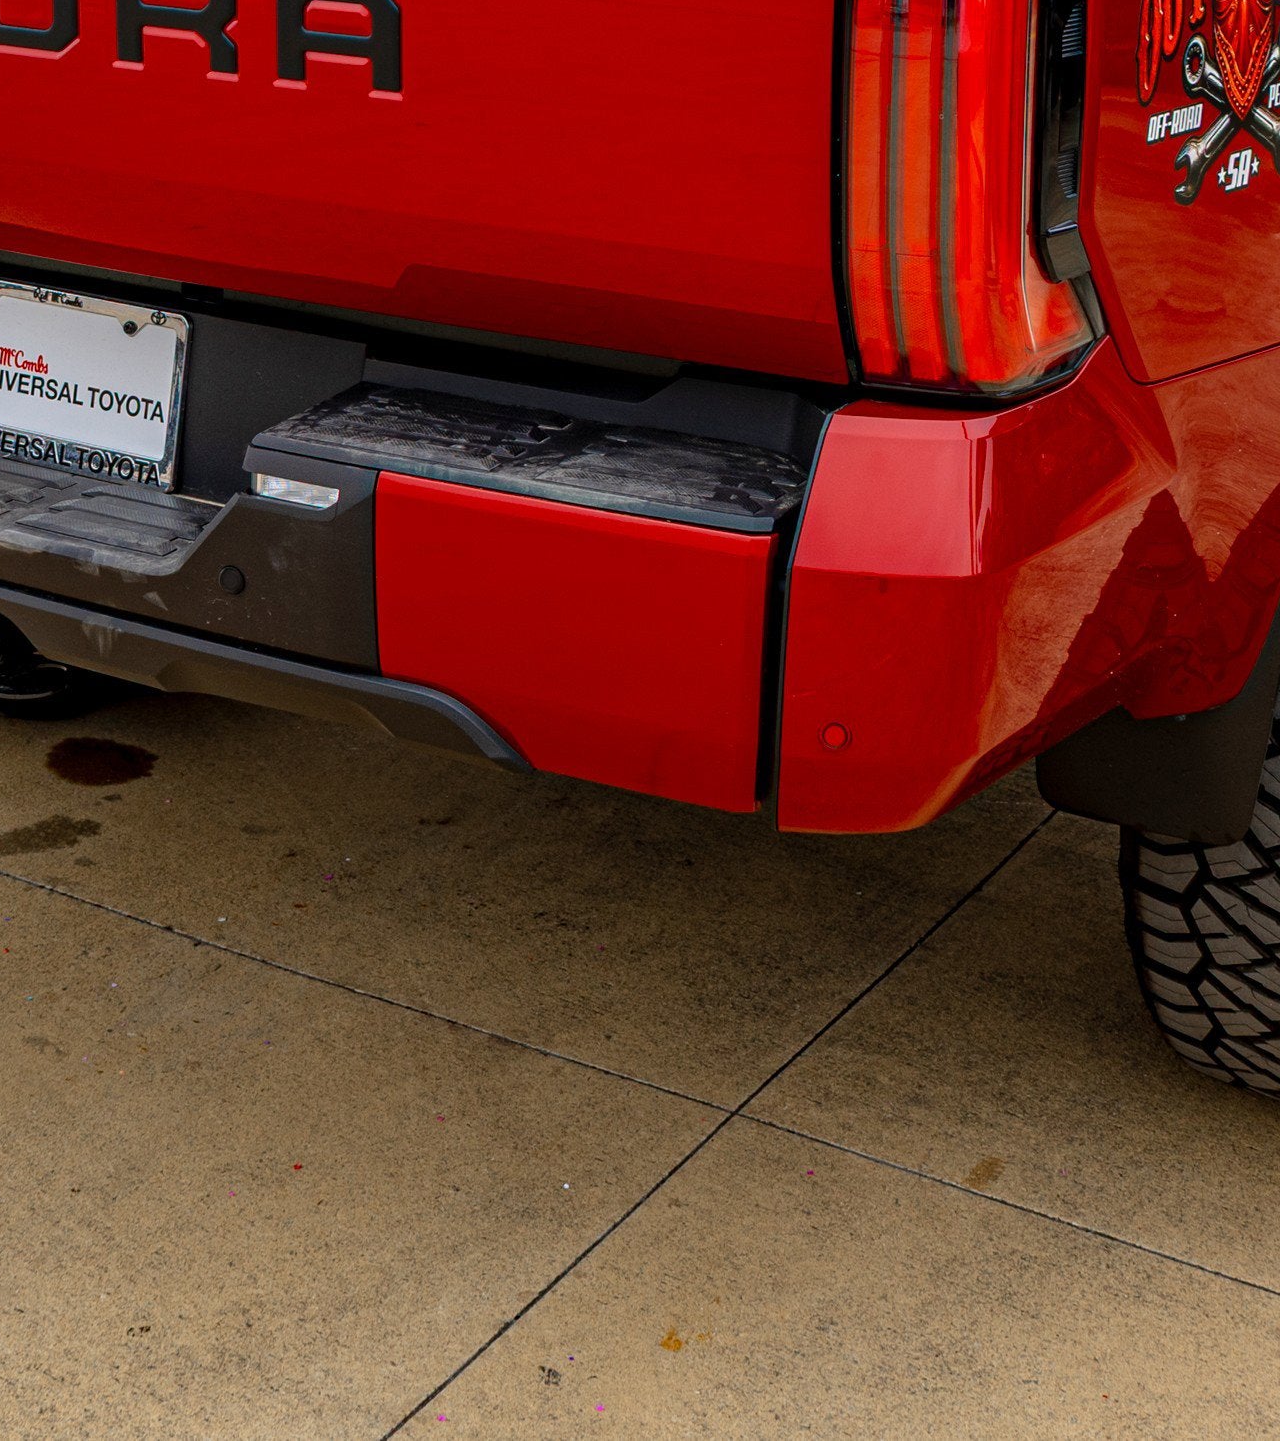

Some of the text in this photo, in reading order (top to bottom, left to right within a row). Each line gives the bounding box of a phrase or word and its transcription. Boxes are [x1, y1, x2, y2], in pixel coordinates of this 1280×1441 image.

[1146, 103, 1203, 144] OFF-ROAD
[1224, 148, 1253, 192] SA
[33, 287, 50, 304] Red
[87, 386, 165, 424] TOYOTA
[75, 446, 162, 488] TOYOTA
